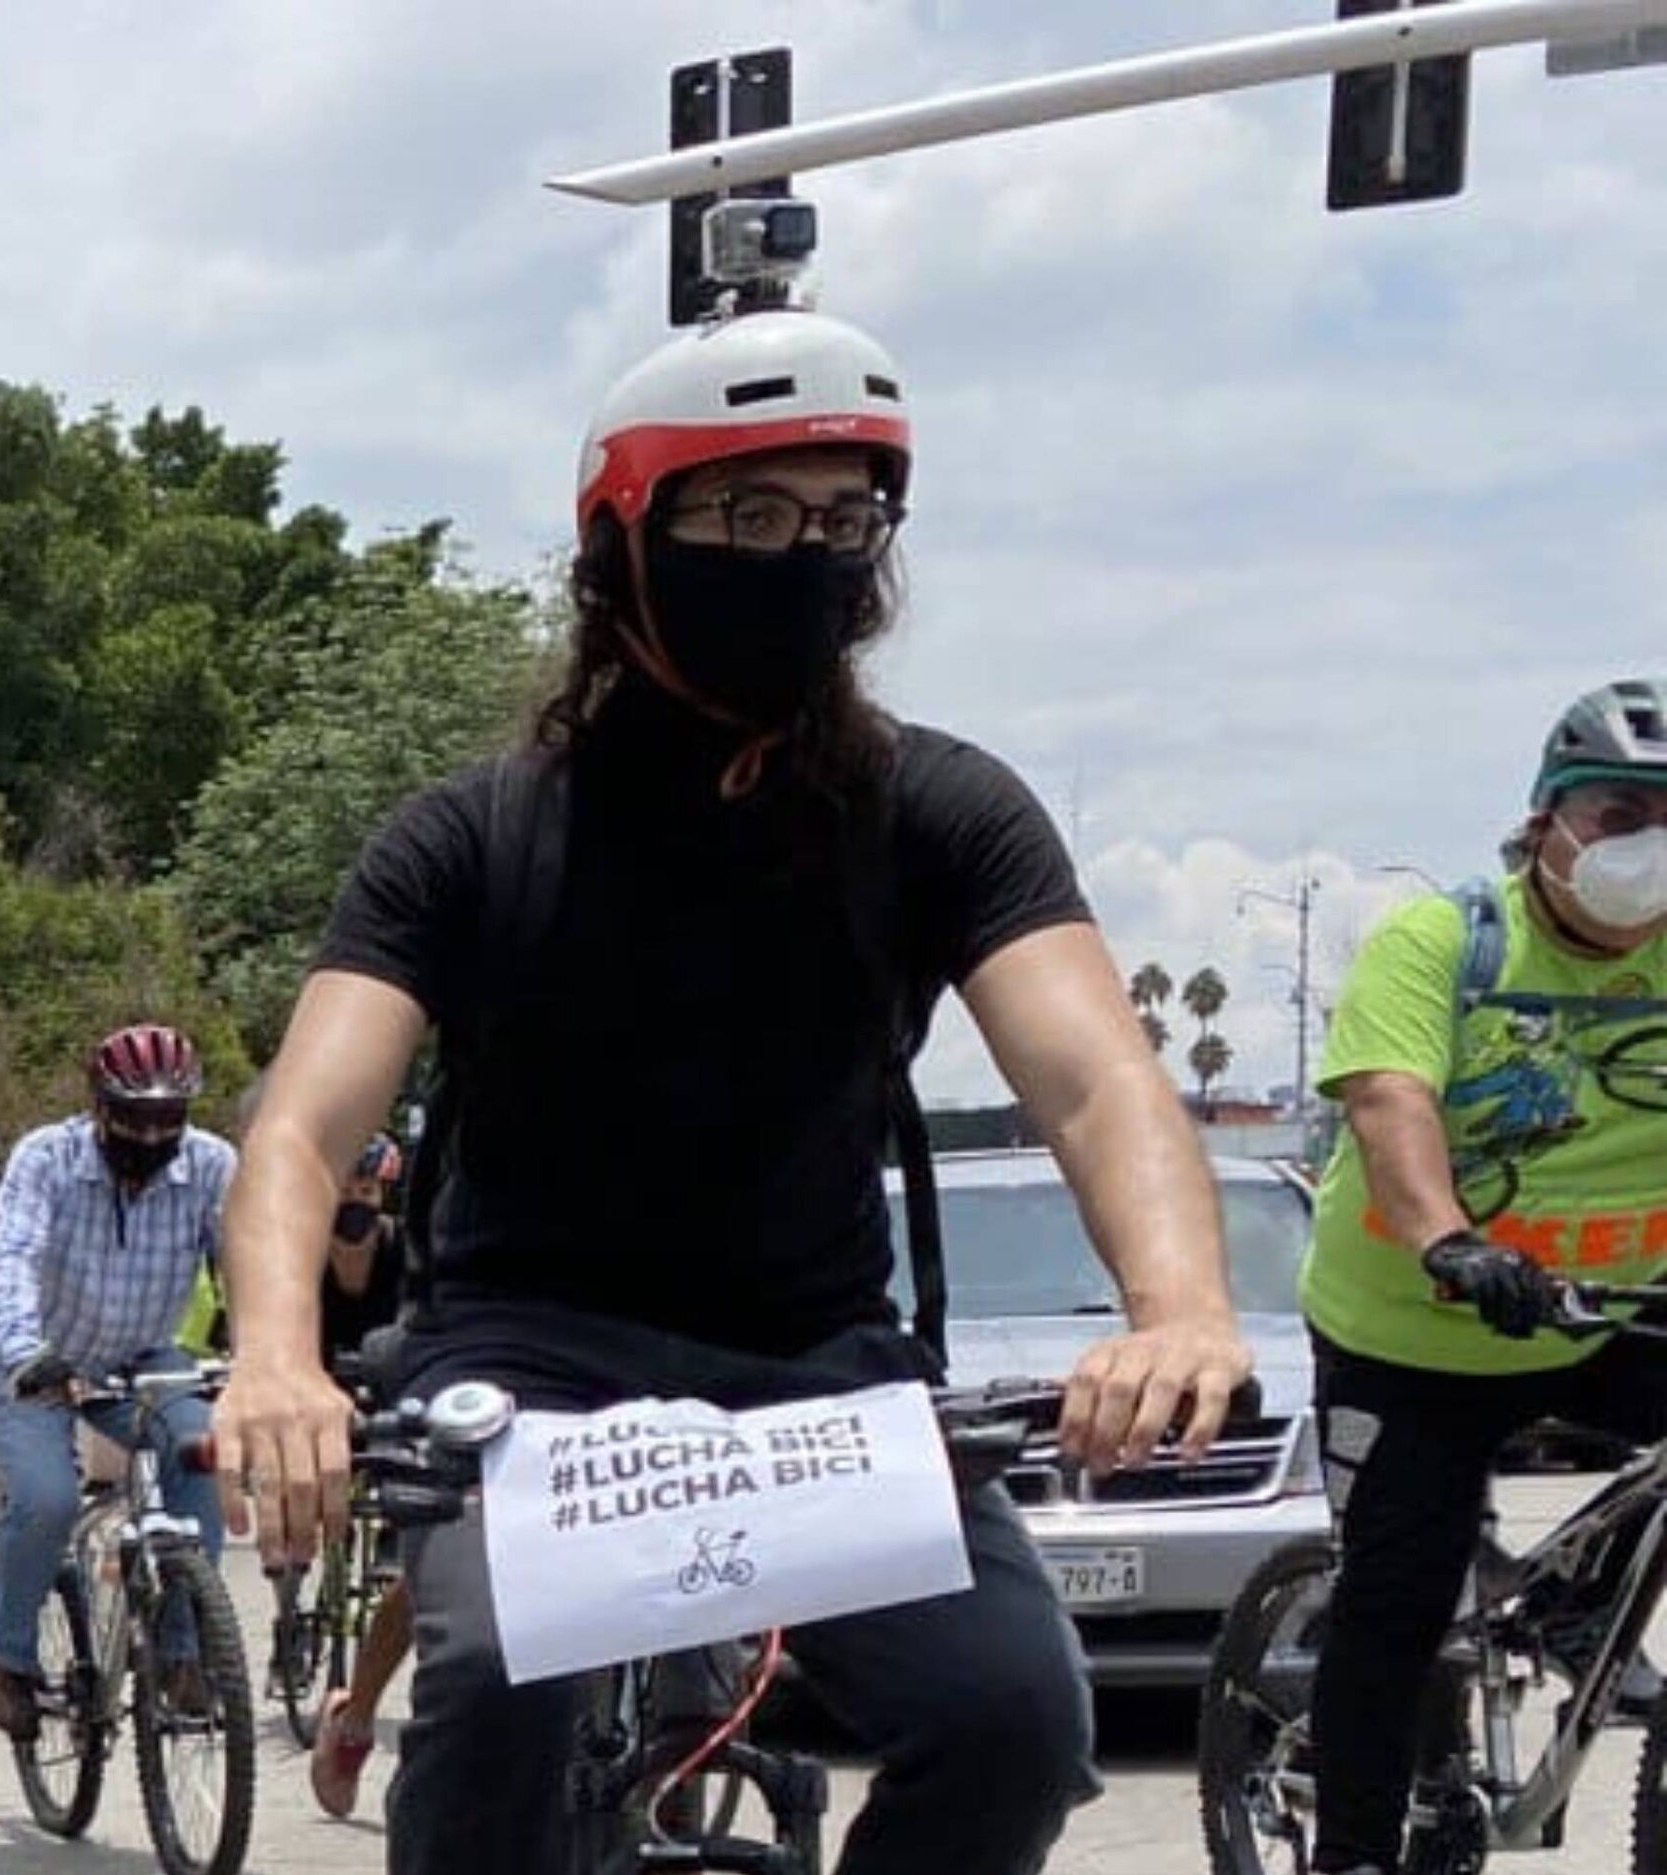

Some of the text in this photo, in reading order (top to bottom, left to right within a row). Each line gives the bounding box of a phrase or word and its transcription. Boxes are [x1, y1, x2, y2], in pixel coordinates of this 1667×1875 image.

[552, 1437, 753, 1497] #LUCHA
[552, 1455, 872, 1532] #LUCHA BICI
